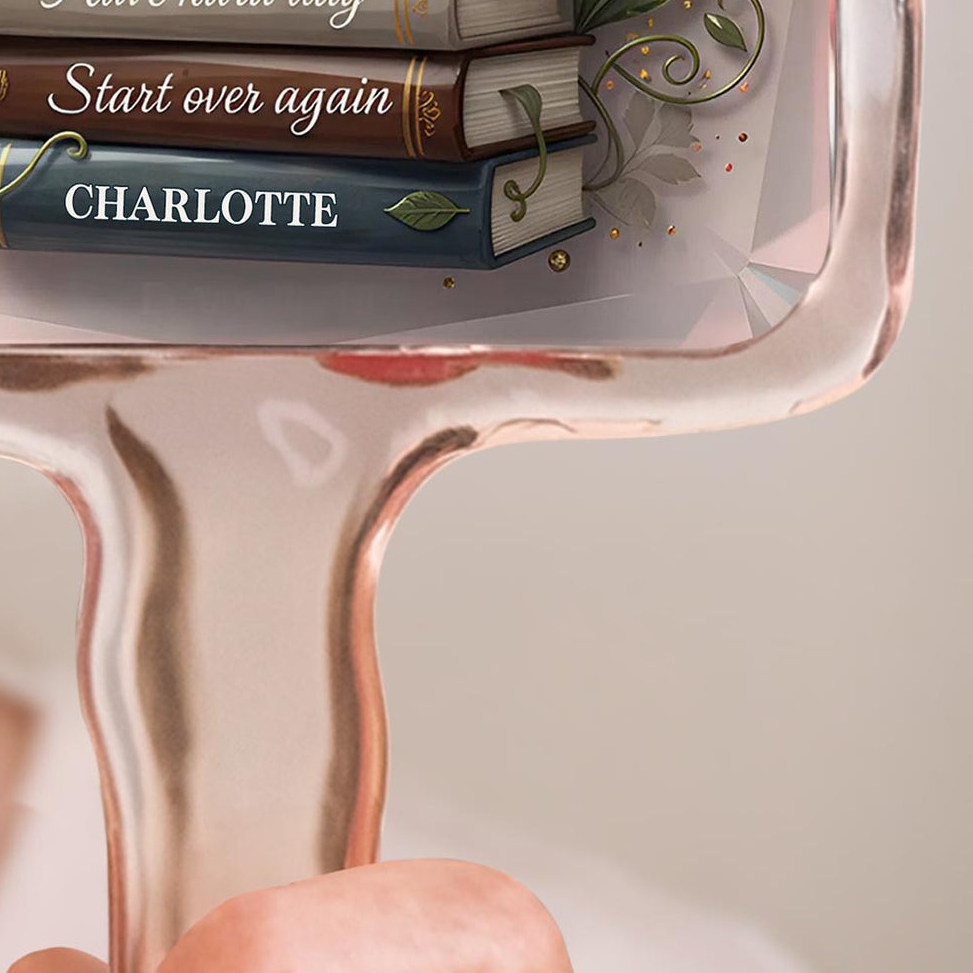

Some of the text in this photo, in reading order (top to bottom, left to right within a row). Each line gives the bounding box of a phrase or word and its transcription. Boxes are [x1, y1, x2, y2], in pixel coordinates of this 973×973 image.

[47, 63, 393, 136] Start over again
[64, 183, 338, 228] CHARLOTTE
